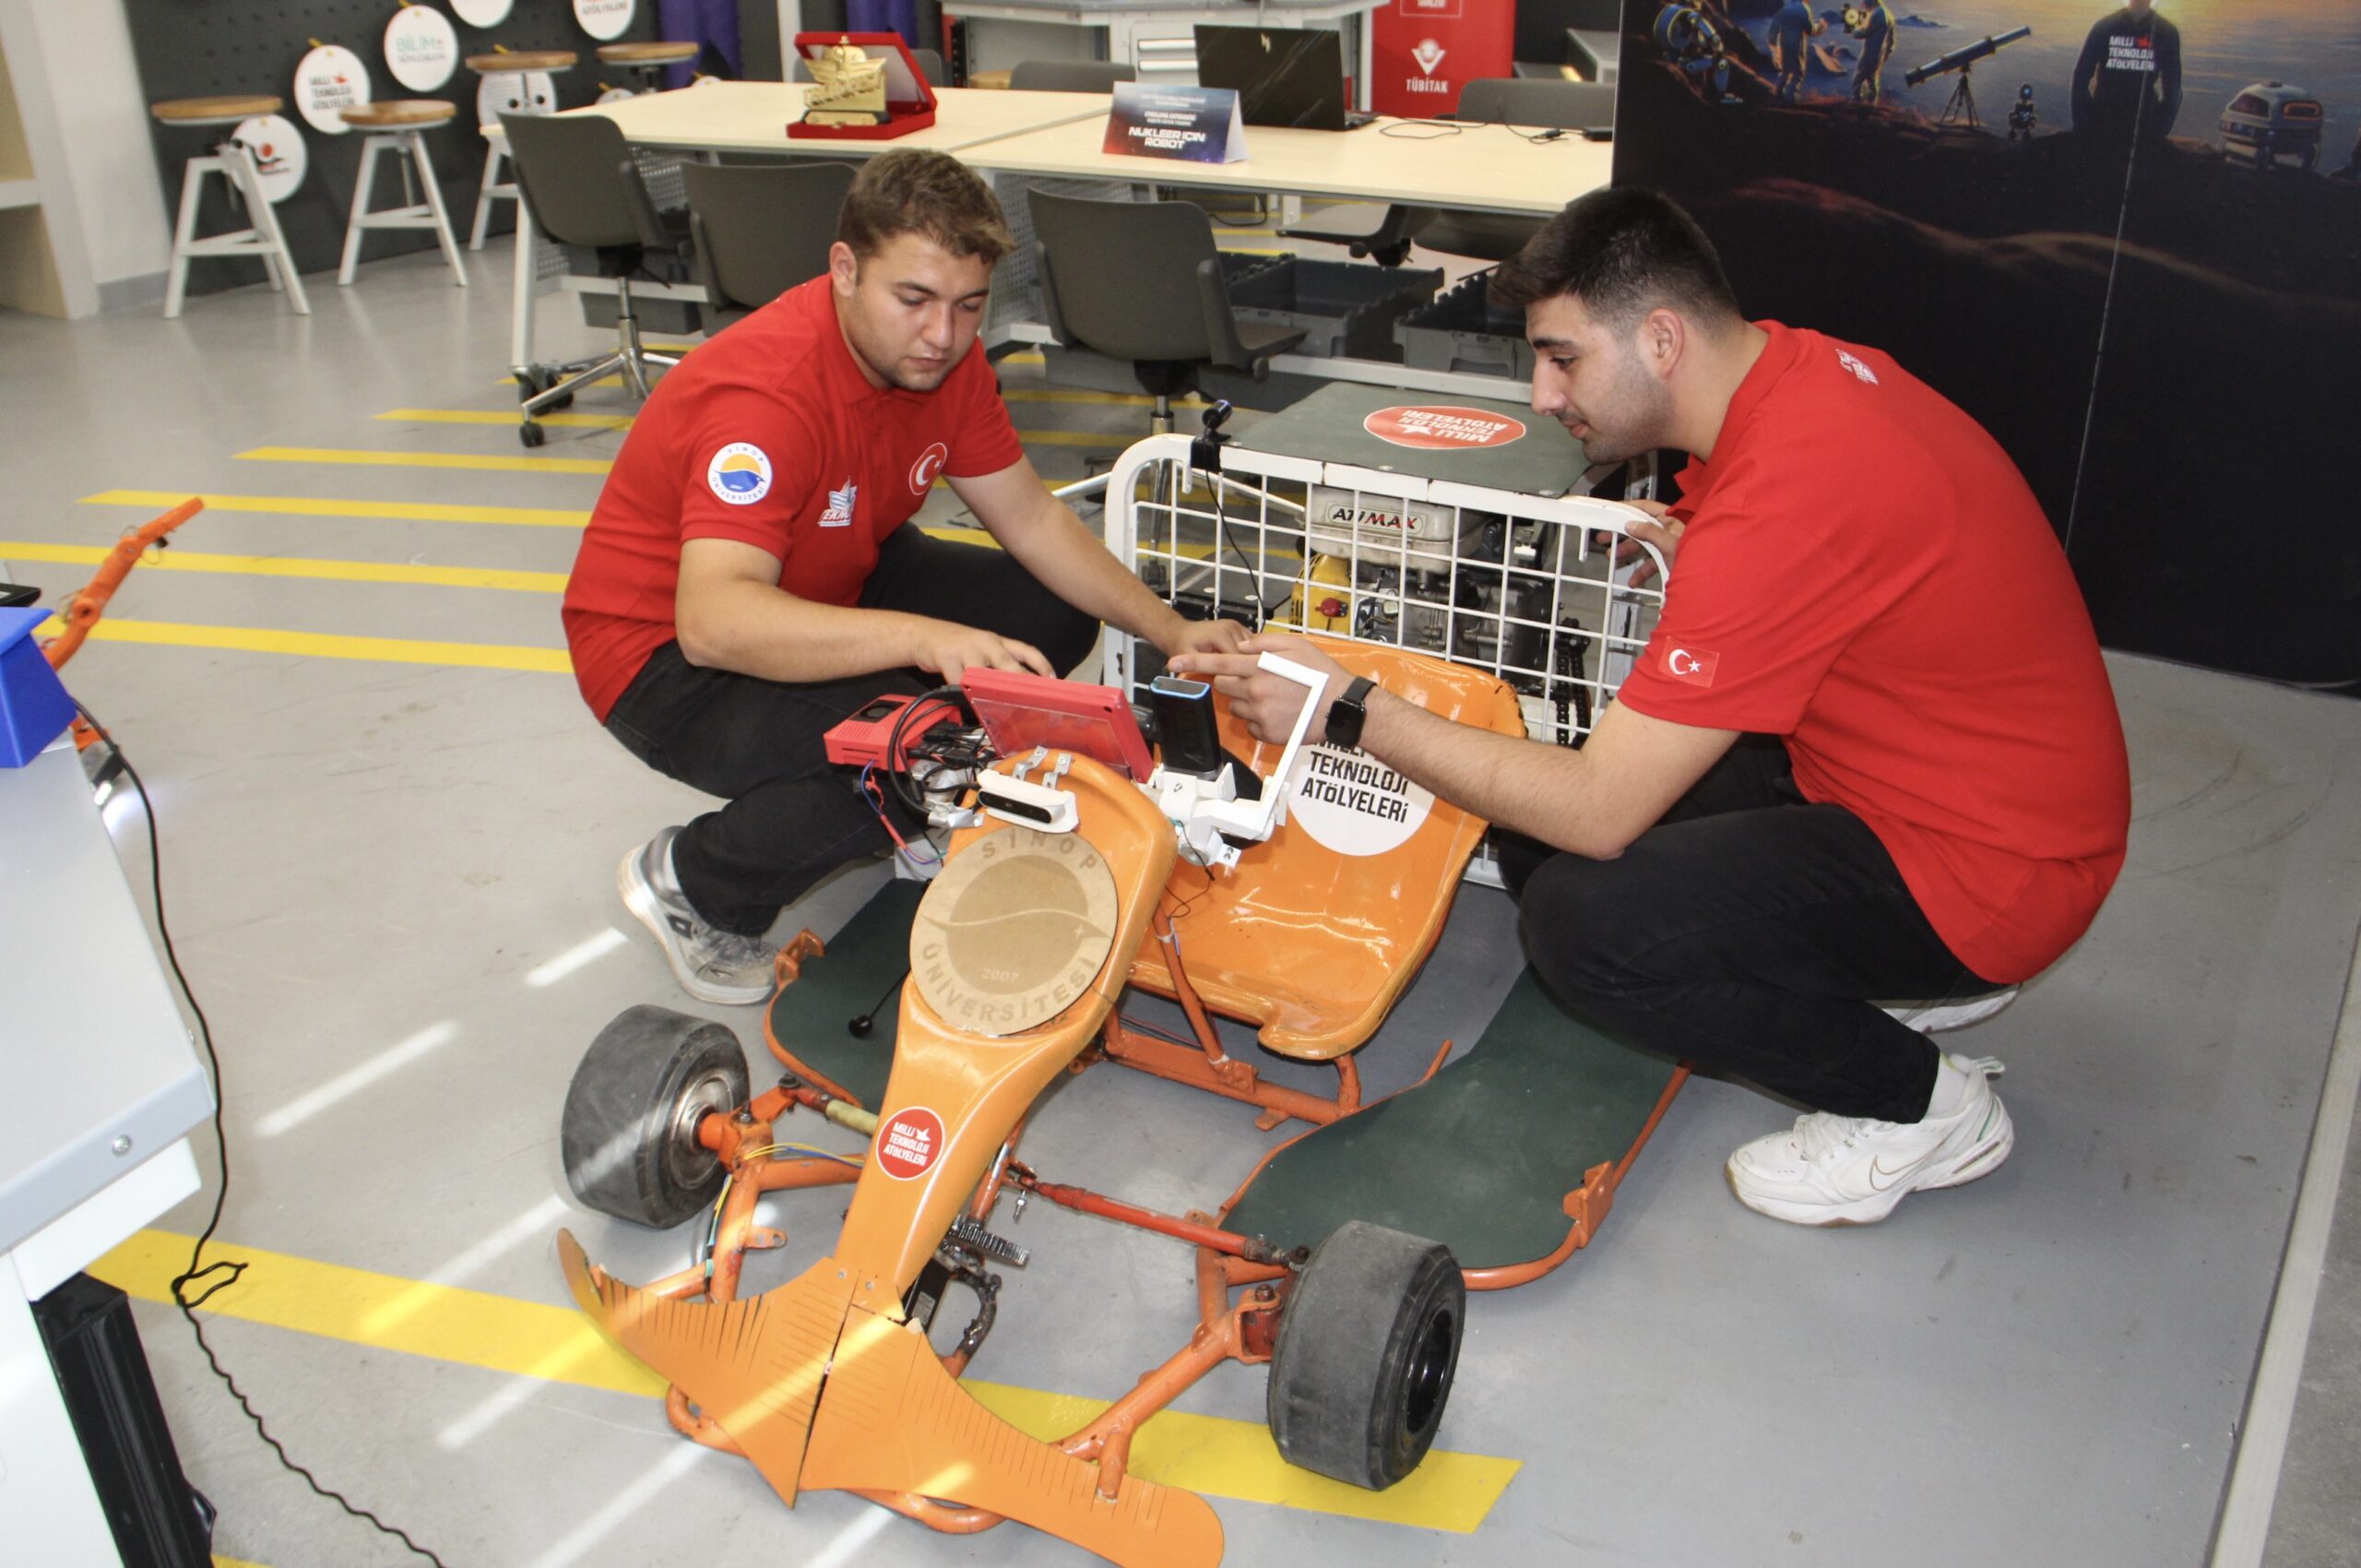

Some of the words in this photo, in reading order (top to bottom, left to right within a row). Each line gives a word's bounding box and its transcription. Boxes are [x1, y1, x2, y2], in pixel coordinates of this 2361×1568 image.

[1406, 77, 1448, 93] TÜBİTAK
[1144, 137, 1185, 149] ROBOT
[1300, 777, 1409, 824] ATÖLYELERİ
[980, 968, 1020, 983] 2007
